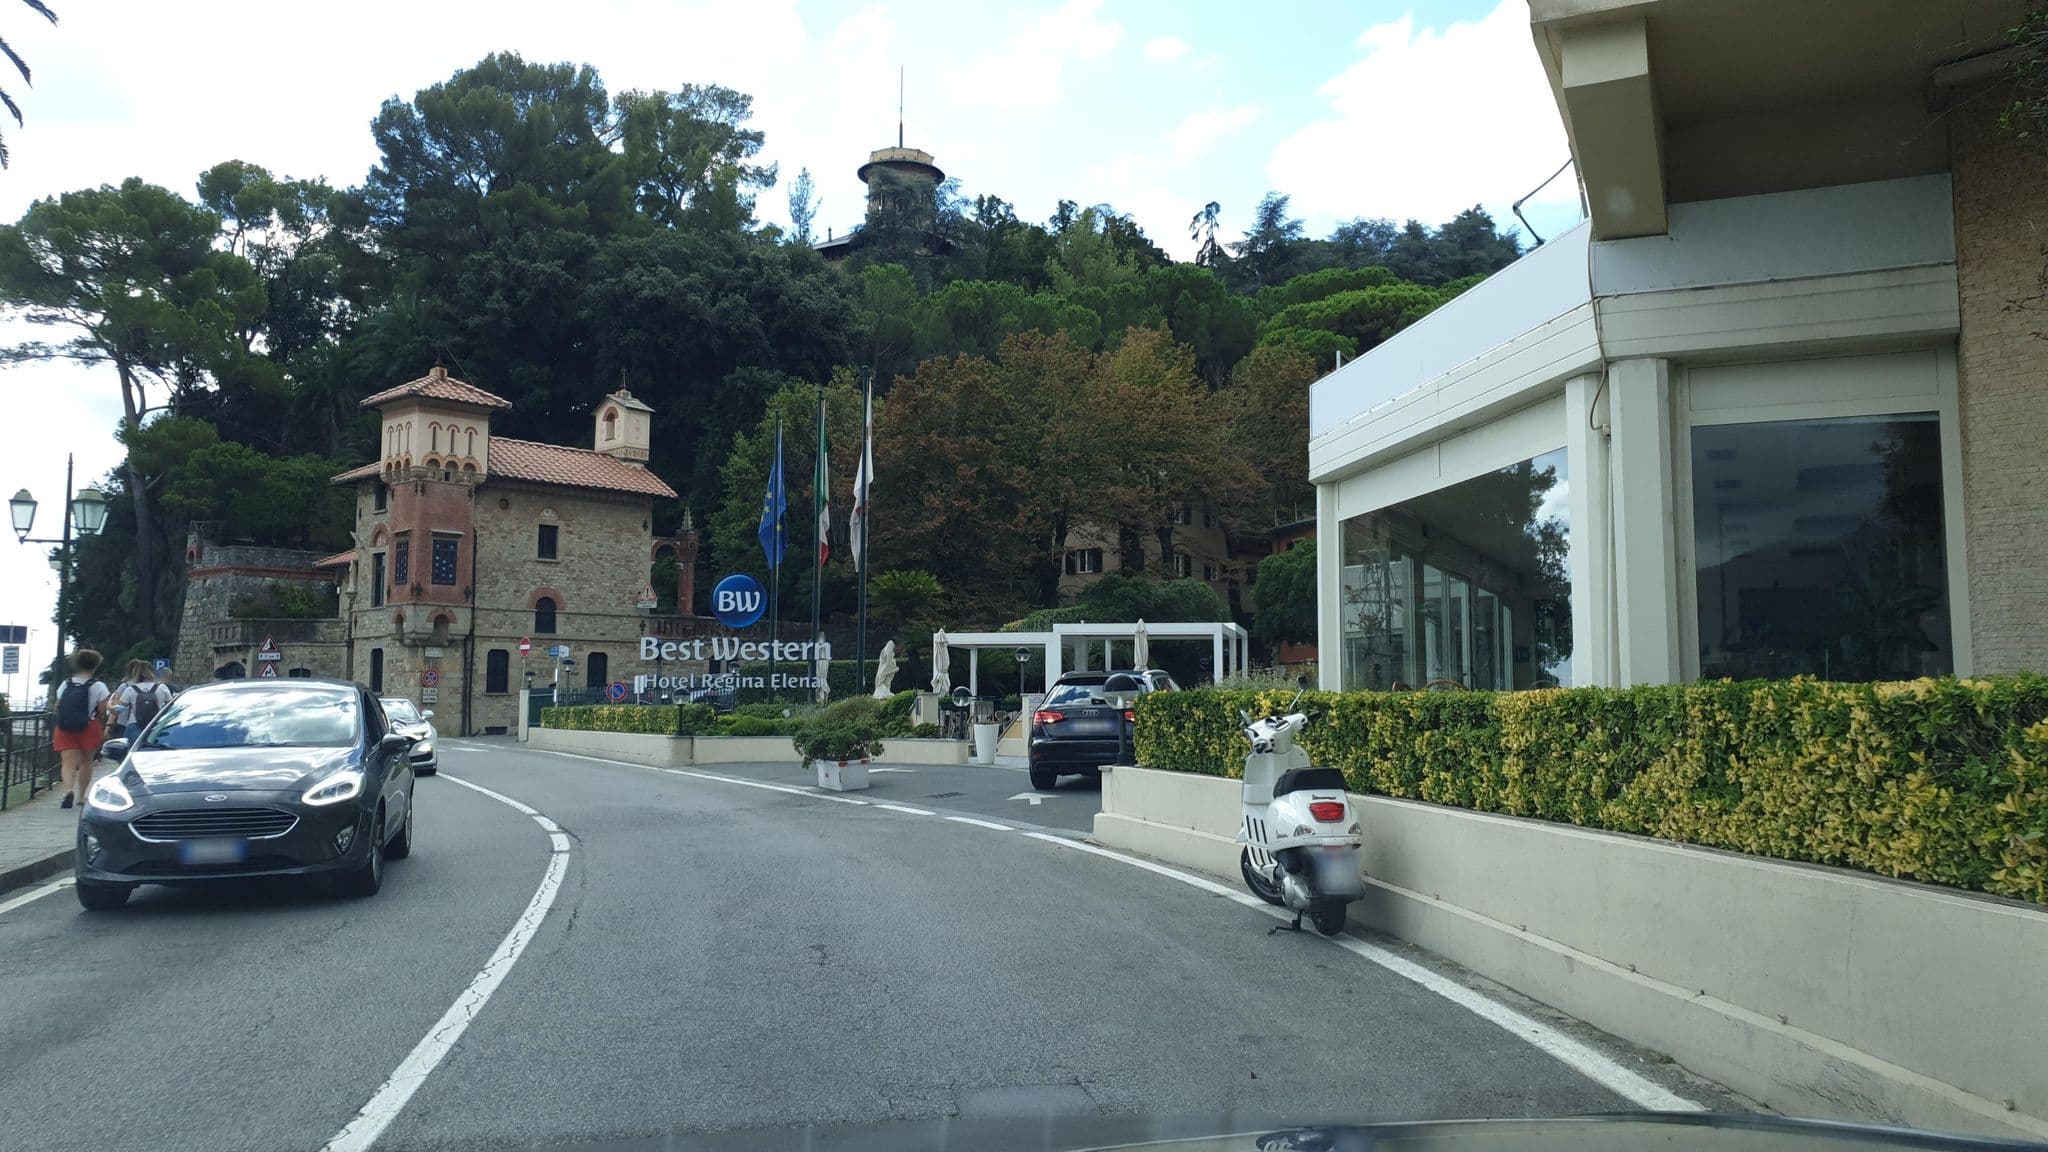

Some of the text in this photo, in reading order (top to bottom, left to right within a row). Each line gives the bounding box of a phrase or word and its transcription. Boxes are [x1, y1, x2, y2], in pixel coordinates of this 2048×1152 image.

[718, 591, 760, 612] BW
[640, 637, 832, 661] Best Western
[156, 661, 165, 670] P
[645, 672, 821, 692] Hotel Regina Elena
